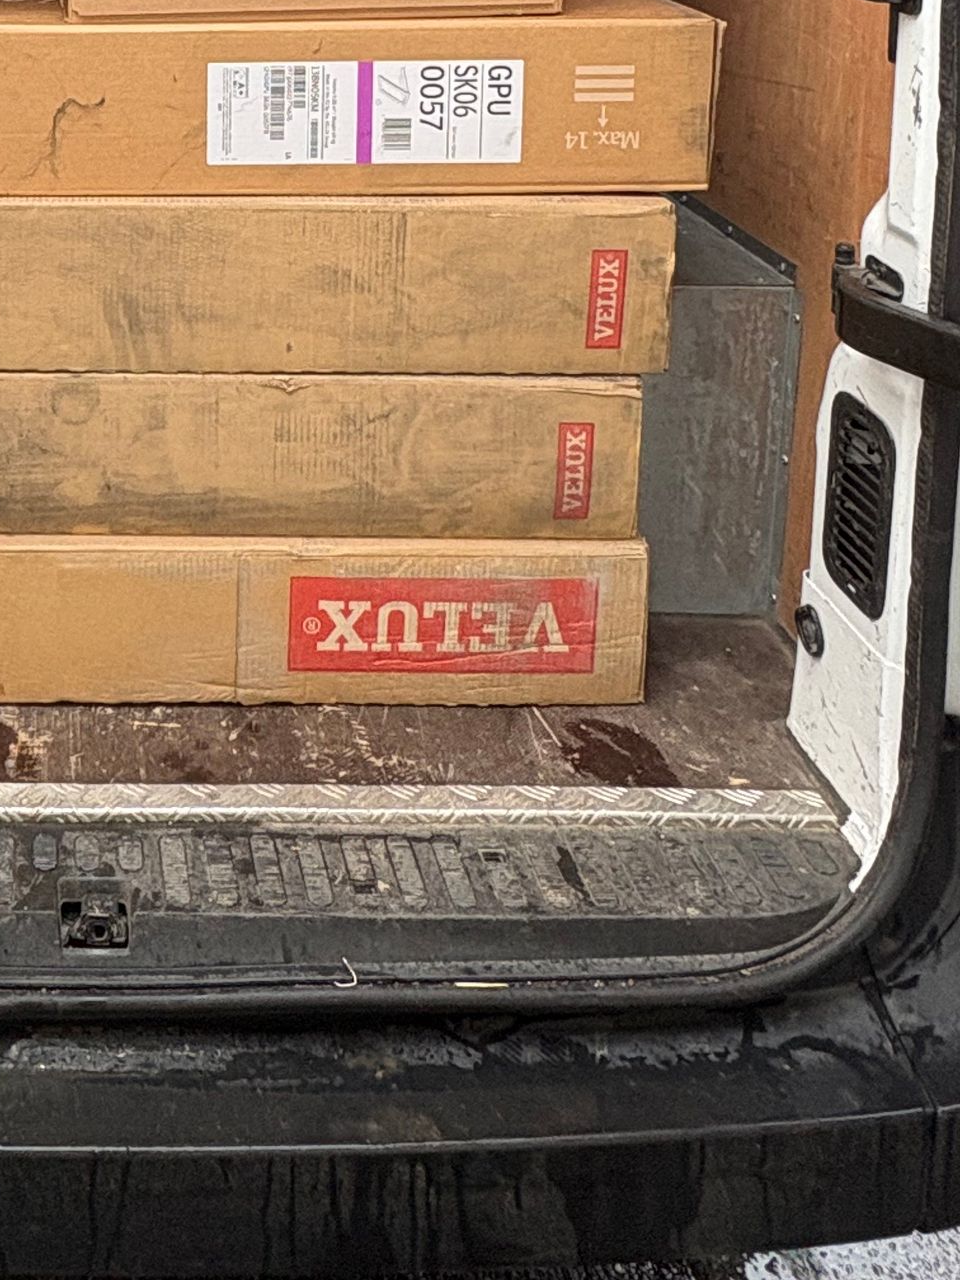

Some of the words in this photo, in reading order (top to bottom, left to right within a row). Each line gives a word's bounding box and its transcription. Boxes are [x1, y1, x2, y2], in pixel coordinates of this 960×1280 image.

[419, 65, 445, 131] 0057
[453, 64, 479, 118] SK06
[487, 65, 513, 116] GPU
[564, 131, 589, 150] 14
[592, 131, 640, 150] Max.
[594, 258, 620, 341] VELUX
